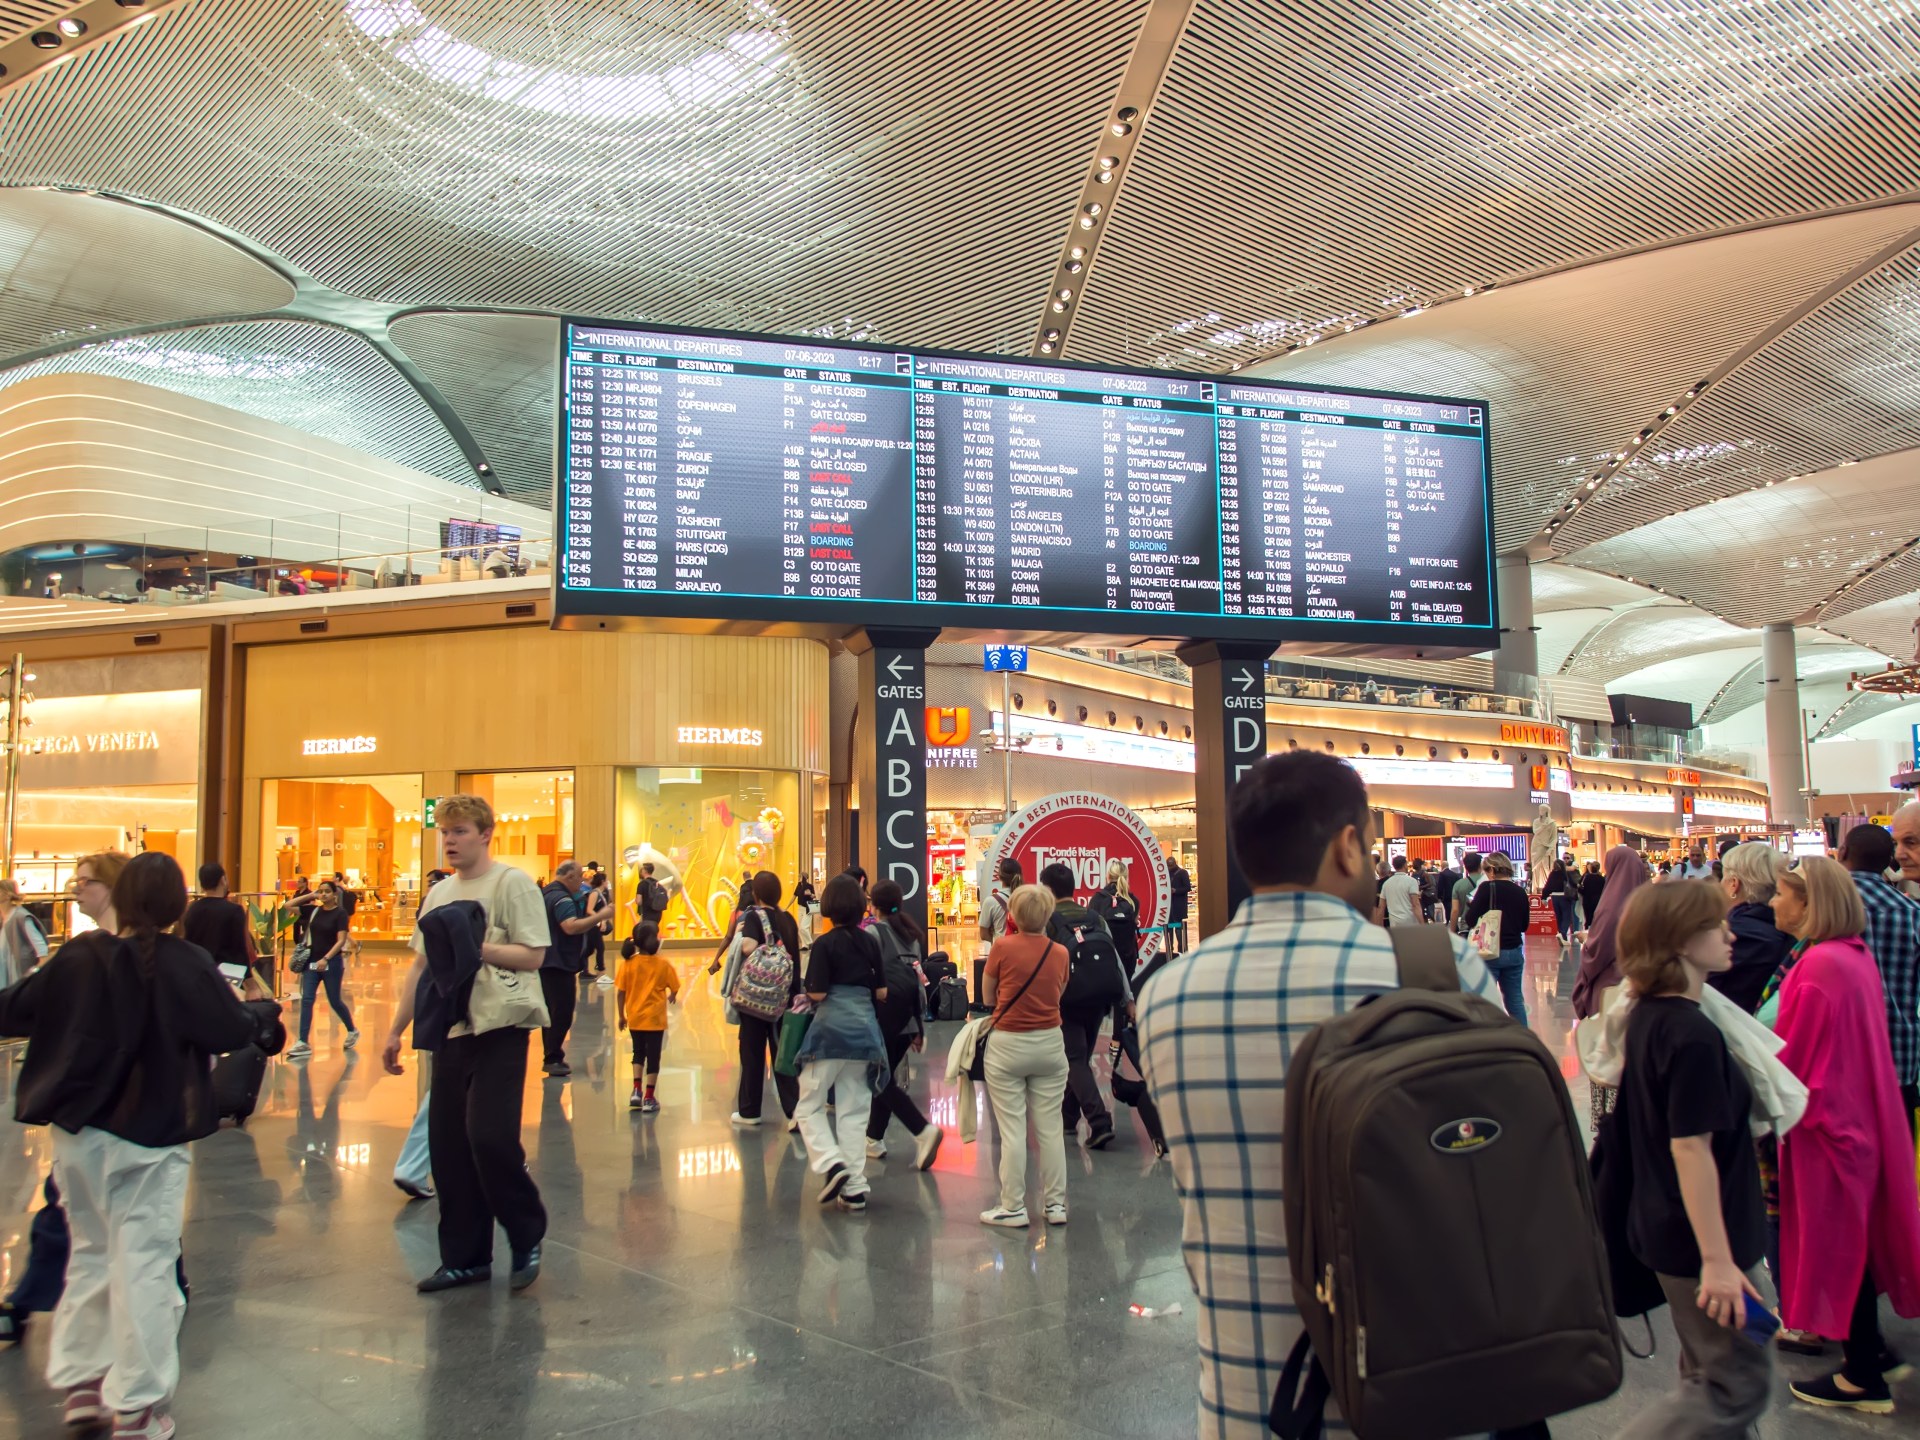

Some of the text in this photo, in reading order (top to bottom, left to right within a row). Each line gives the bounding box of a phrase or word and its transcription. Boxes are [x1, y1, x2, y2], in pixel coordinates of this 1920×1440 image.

[589, 333, 881, 367] INTERNATIONAL DEPARTURES 07-06-2023 12:17
[571, 351, 851, 382] TIME EST. FLIGHT DESTINATION GATE STATUS
[571, 366, 866, 397] 11:35 12:25 TK 1943 BRUSSELS B2 GATE CLOSED
[930, 362, 1002, 378] INTERNATIONAL
[1004, 369, 1065, 384] DEPARTURES
[1167, 384, 1188, 395] 12:17
[571, 392, 736, 412] 11:50 COPENHAGEN
[914, 379, 1162, 408] TIME EST. FLIGHT DESTINATION GATE STATUS
[1230, 389, 1458, 419] INTERNATIONAL DEPARTURES 07-06-2023 12:17
[1217, 405, 1435, 432] TIME EST. FLIGHT DESTINATION GATE STATUS
[915, 430, 935, 440] 13:00
[570, 445, 867, 472] 12:10 PRAGUE GATE CLOSED
[915, 467, 1172, 493] 13:10 LONDON (LHR) A2 GO TO GATE
[1009, 486, 1072, 498] YEKATERINBURG
[915, 504, 935, 514] 13:15
[942, 506, 962, 515] 13:30
[964, 507, 975, 516] PK
[1010, 510, 1026, 519] LOS
[1026, 511, 1062, 521] ANGELES
[1104, 516, 1114, 524] B1
[569, 524, 853, 546] 12:30 TK 1703 STUTTGART B12A BOARDING
[568, 537, 804, 557] 12:35 PARIS (CDG) B12B
[916, 541, 936, 551] 13:20
[943, 543, 962, 552] 14:00
[964, 544, 976, 553] UX
[1011, 547, 1040, 556] MADRID
[1129, 553, 1149, 562] GATE
[1150, 554, 1167, 563] INFO
[1168, 555, 1180, 564] AT:
[1181, 556, 1199, 565] 12:30
[1221, 546, 1458, 568] 13:45 MANCHESTER WAIT FOR GATE
[568, 577, 860, 597] 12:50 TK 1023 SARAJEVO D4 GO TO GATE
[1222, 569, 1240, 578] 13:45
[1246, 571, 1264, 580] 14:00
[1264, 572, 1275, 580] TK
[1305, 574, 1346, 584] BUCHAREST
[1409, 580, 1427, 588] GATE
[1428, 581, 1444, 589] INFO
[1443, 582, 1455, 590] AT:
[1455, 582, 1472, 591] 12:45
[916, 591, 1175, 611] 13:20 TK 1977 DUBLIN F2 GO TO GATE
[1306, 597, 1337, 607] ATLANTA
[1411, 602, 1419, 611] 10
[1432, 604, 1462, 613] DELAYED
[1224, 605, 1242, 614] 13:50
[1247, 606, 1265, 615] 14:05
[1266, 607, 1276, 615] TK
[1306, 609, 1335, 618] LONDON
[1390, 613, 1400, 621] D5
[1433, 615, 1463, 624] DELAYED
[877, 685, 924, 699] GATES
[1224, 696, 1264, 709] GATES
[886, 708, 916, 746] A
[1233, 717, 1260, 753] D
[1501, 724, 1540, 743] DUTY
[87, 731, 160, 752] VENETA
[925, 759, 978, 768] UTYFREE
[927, 748, 978, 759] NIFREE
[888, 759, 912, 797] B
[886, 810, 914, 849] C
[1714, 825, 1767, 834] DUTY FREE
[1026, 801, 1052, 822] BEST
[1055, 795, 1145, 835] INTERNATIONAL
[1143, 836, 1168, 888] AIRPORT
[1049, 846, 1100, 857] Condé Nast
[888, 862, 920, 900] D
